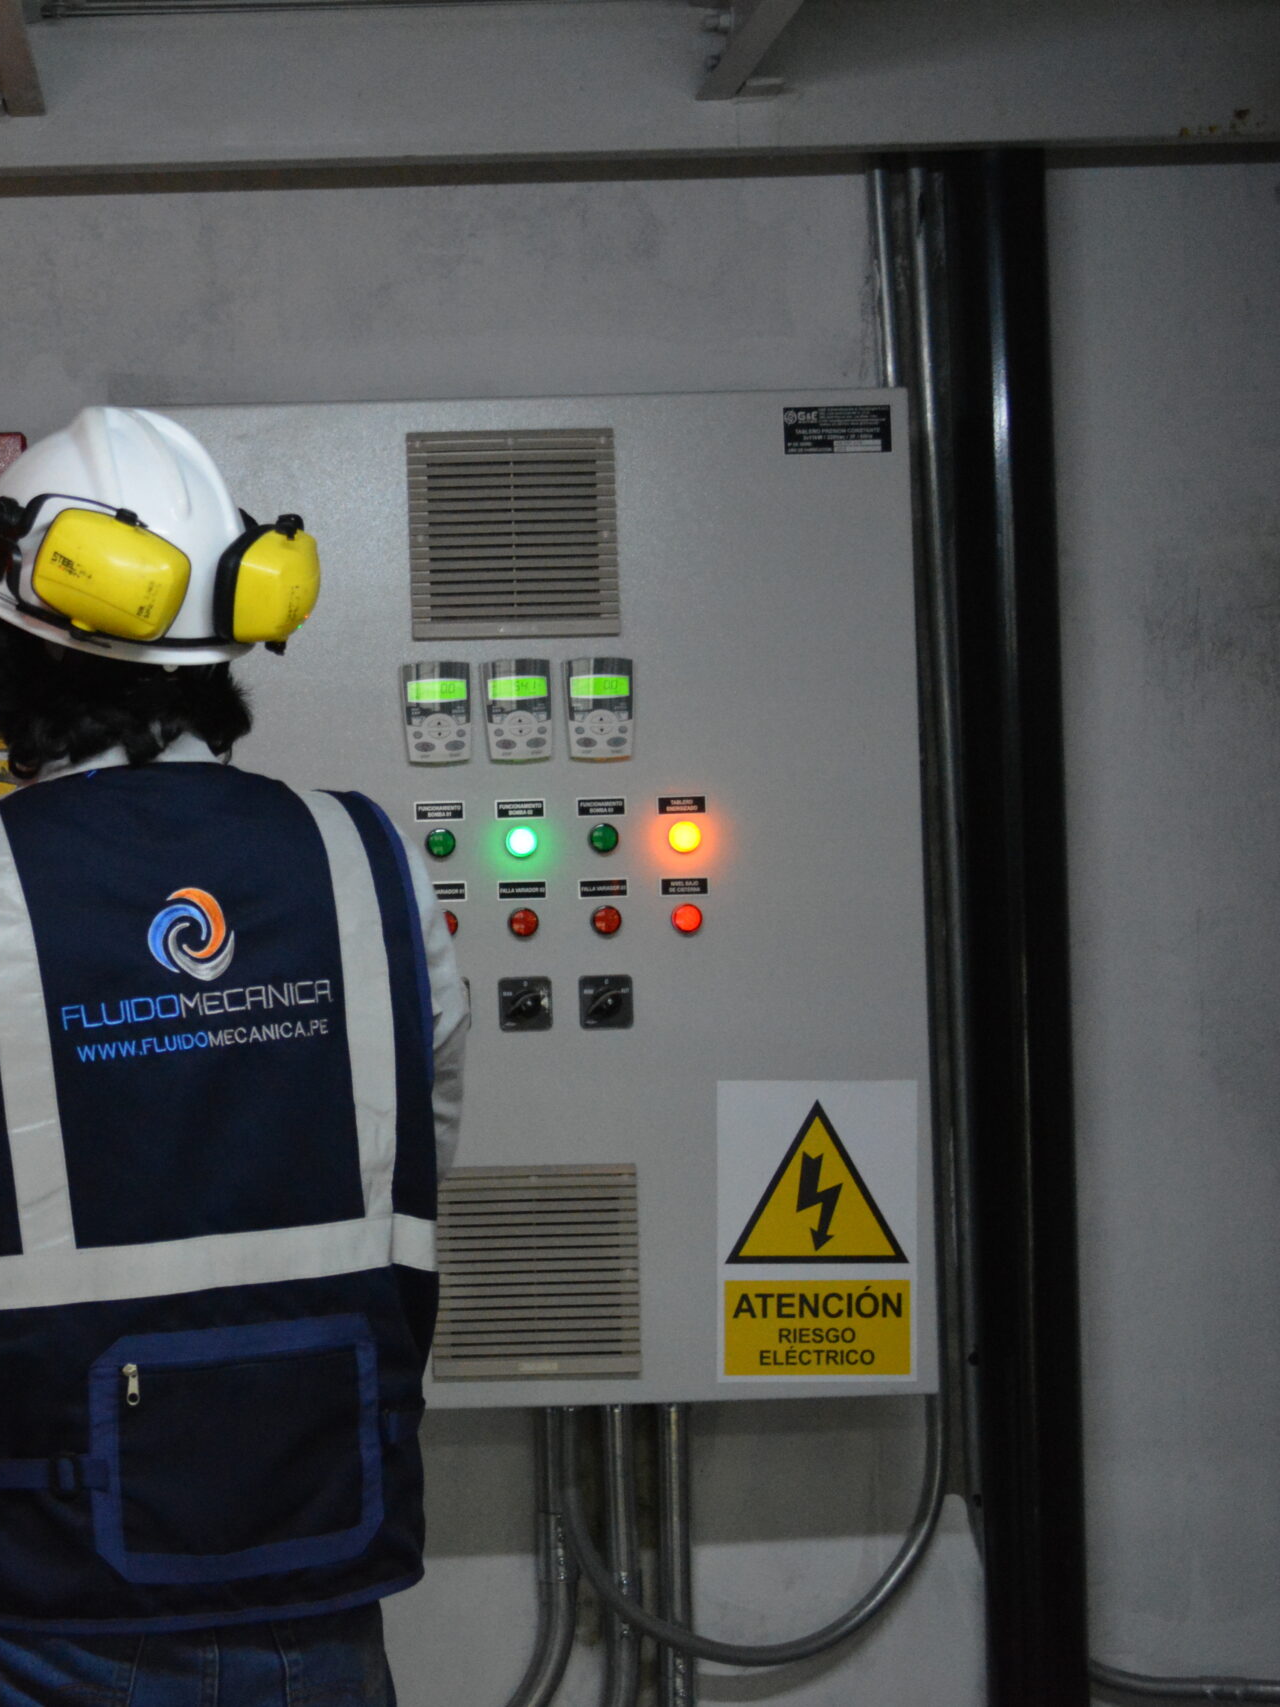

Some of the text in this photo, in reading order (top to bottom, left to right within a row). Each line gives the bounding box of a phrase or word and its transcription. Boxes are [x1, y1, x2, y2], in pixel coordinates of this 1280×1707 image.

[61, 980, 332, 1030] FLUIDOMECANICA
[77, 1019, 329, 1063] WWW.FLUIDOMECANICA.PE
[733, 1286, 902, 1318] ATENCIÓN
[778, 1328, 856, 1344] RIESGO
[760, 1346, 875, 1366] ELÉCTRICO
